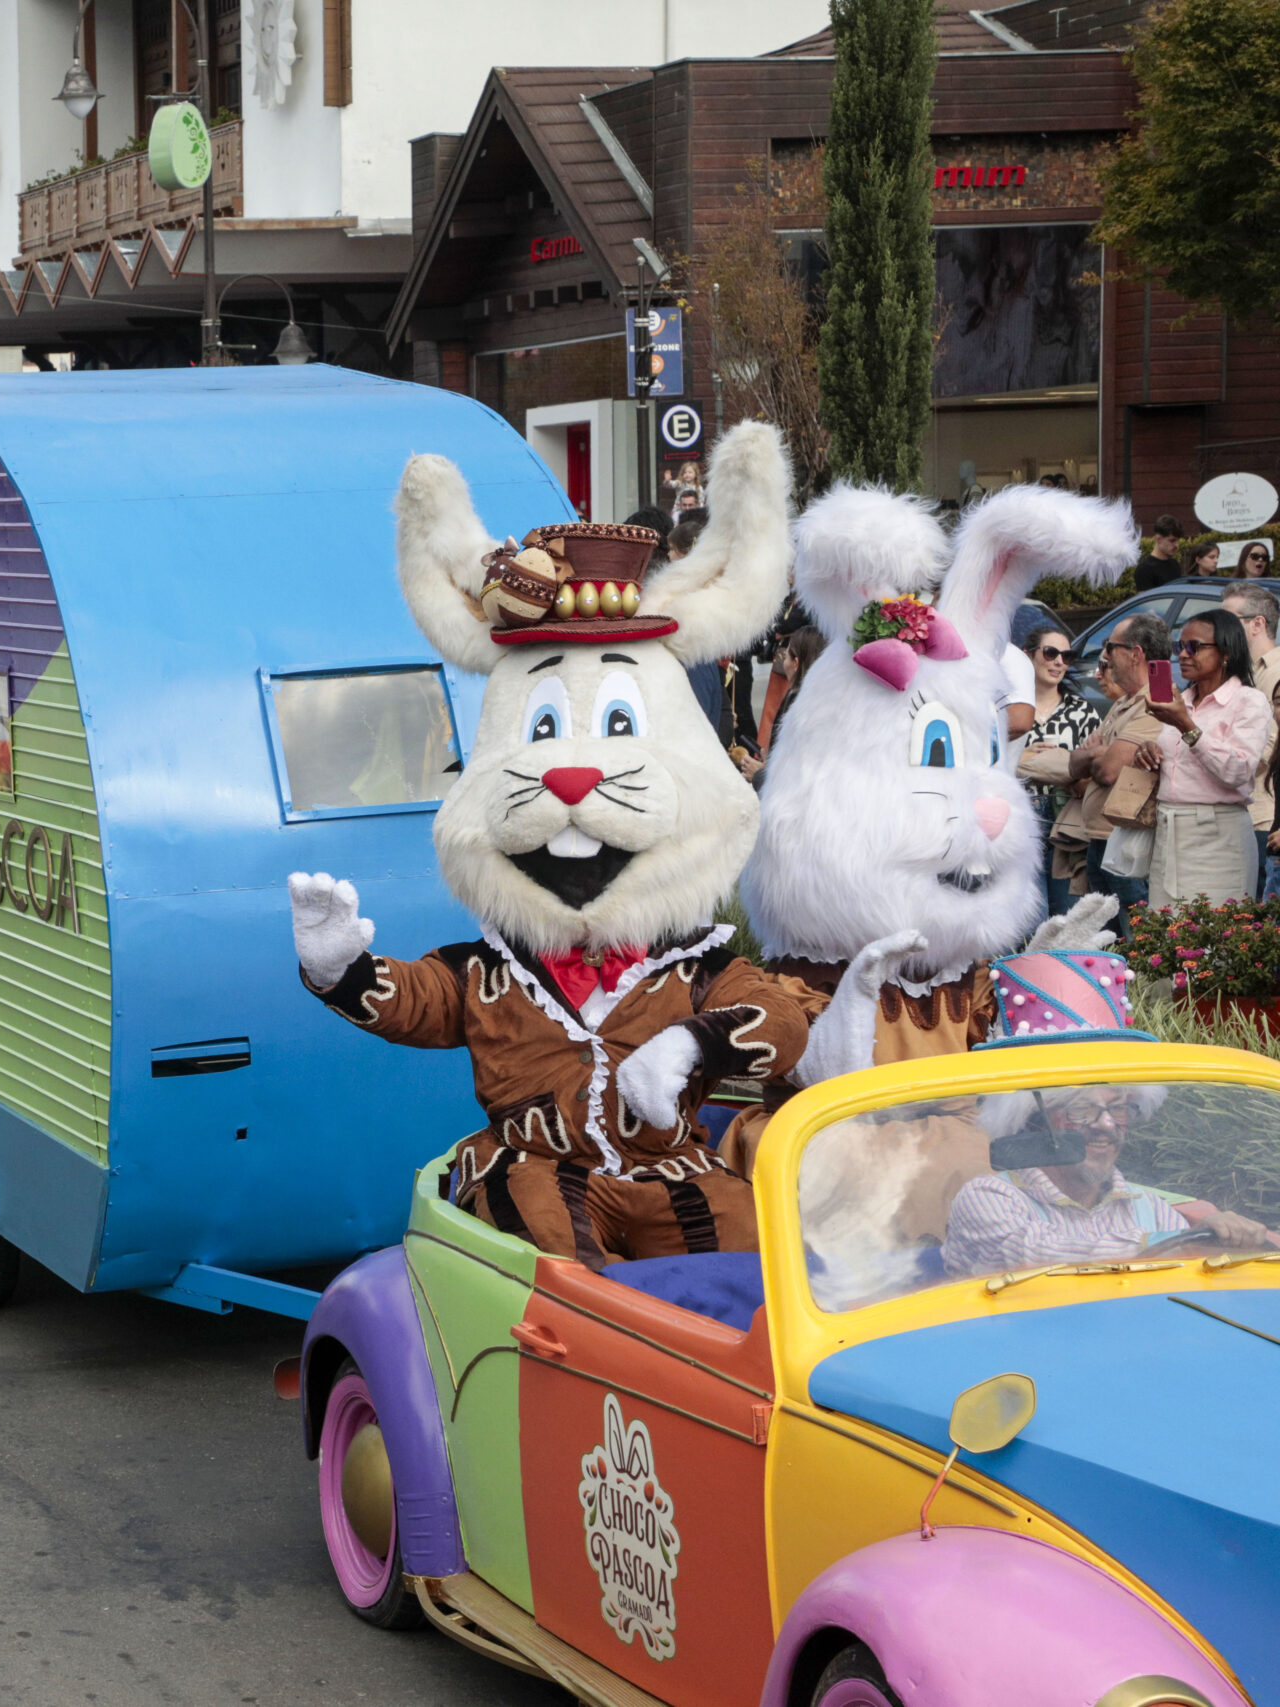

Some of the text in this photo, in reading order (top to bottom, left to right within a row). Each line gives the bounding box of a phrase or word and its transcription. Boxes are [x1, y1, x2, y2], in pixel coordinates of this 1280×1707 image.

[672, 413, 691, 439] E
[599, 1482, 656, 1549] CHOCO
[590, 1531, 671, 1620] PÁSCOA
[617, 1590, 654, 1625] GRAMADO
